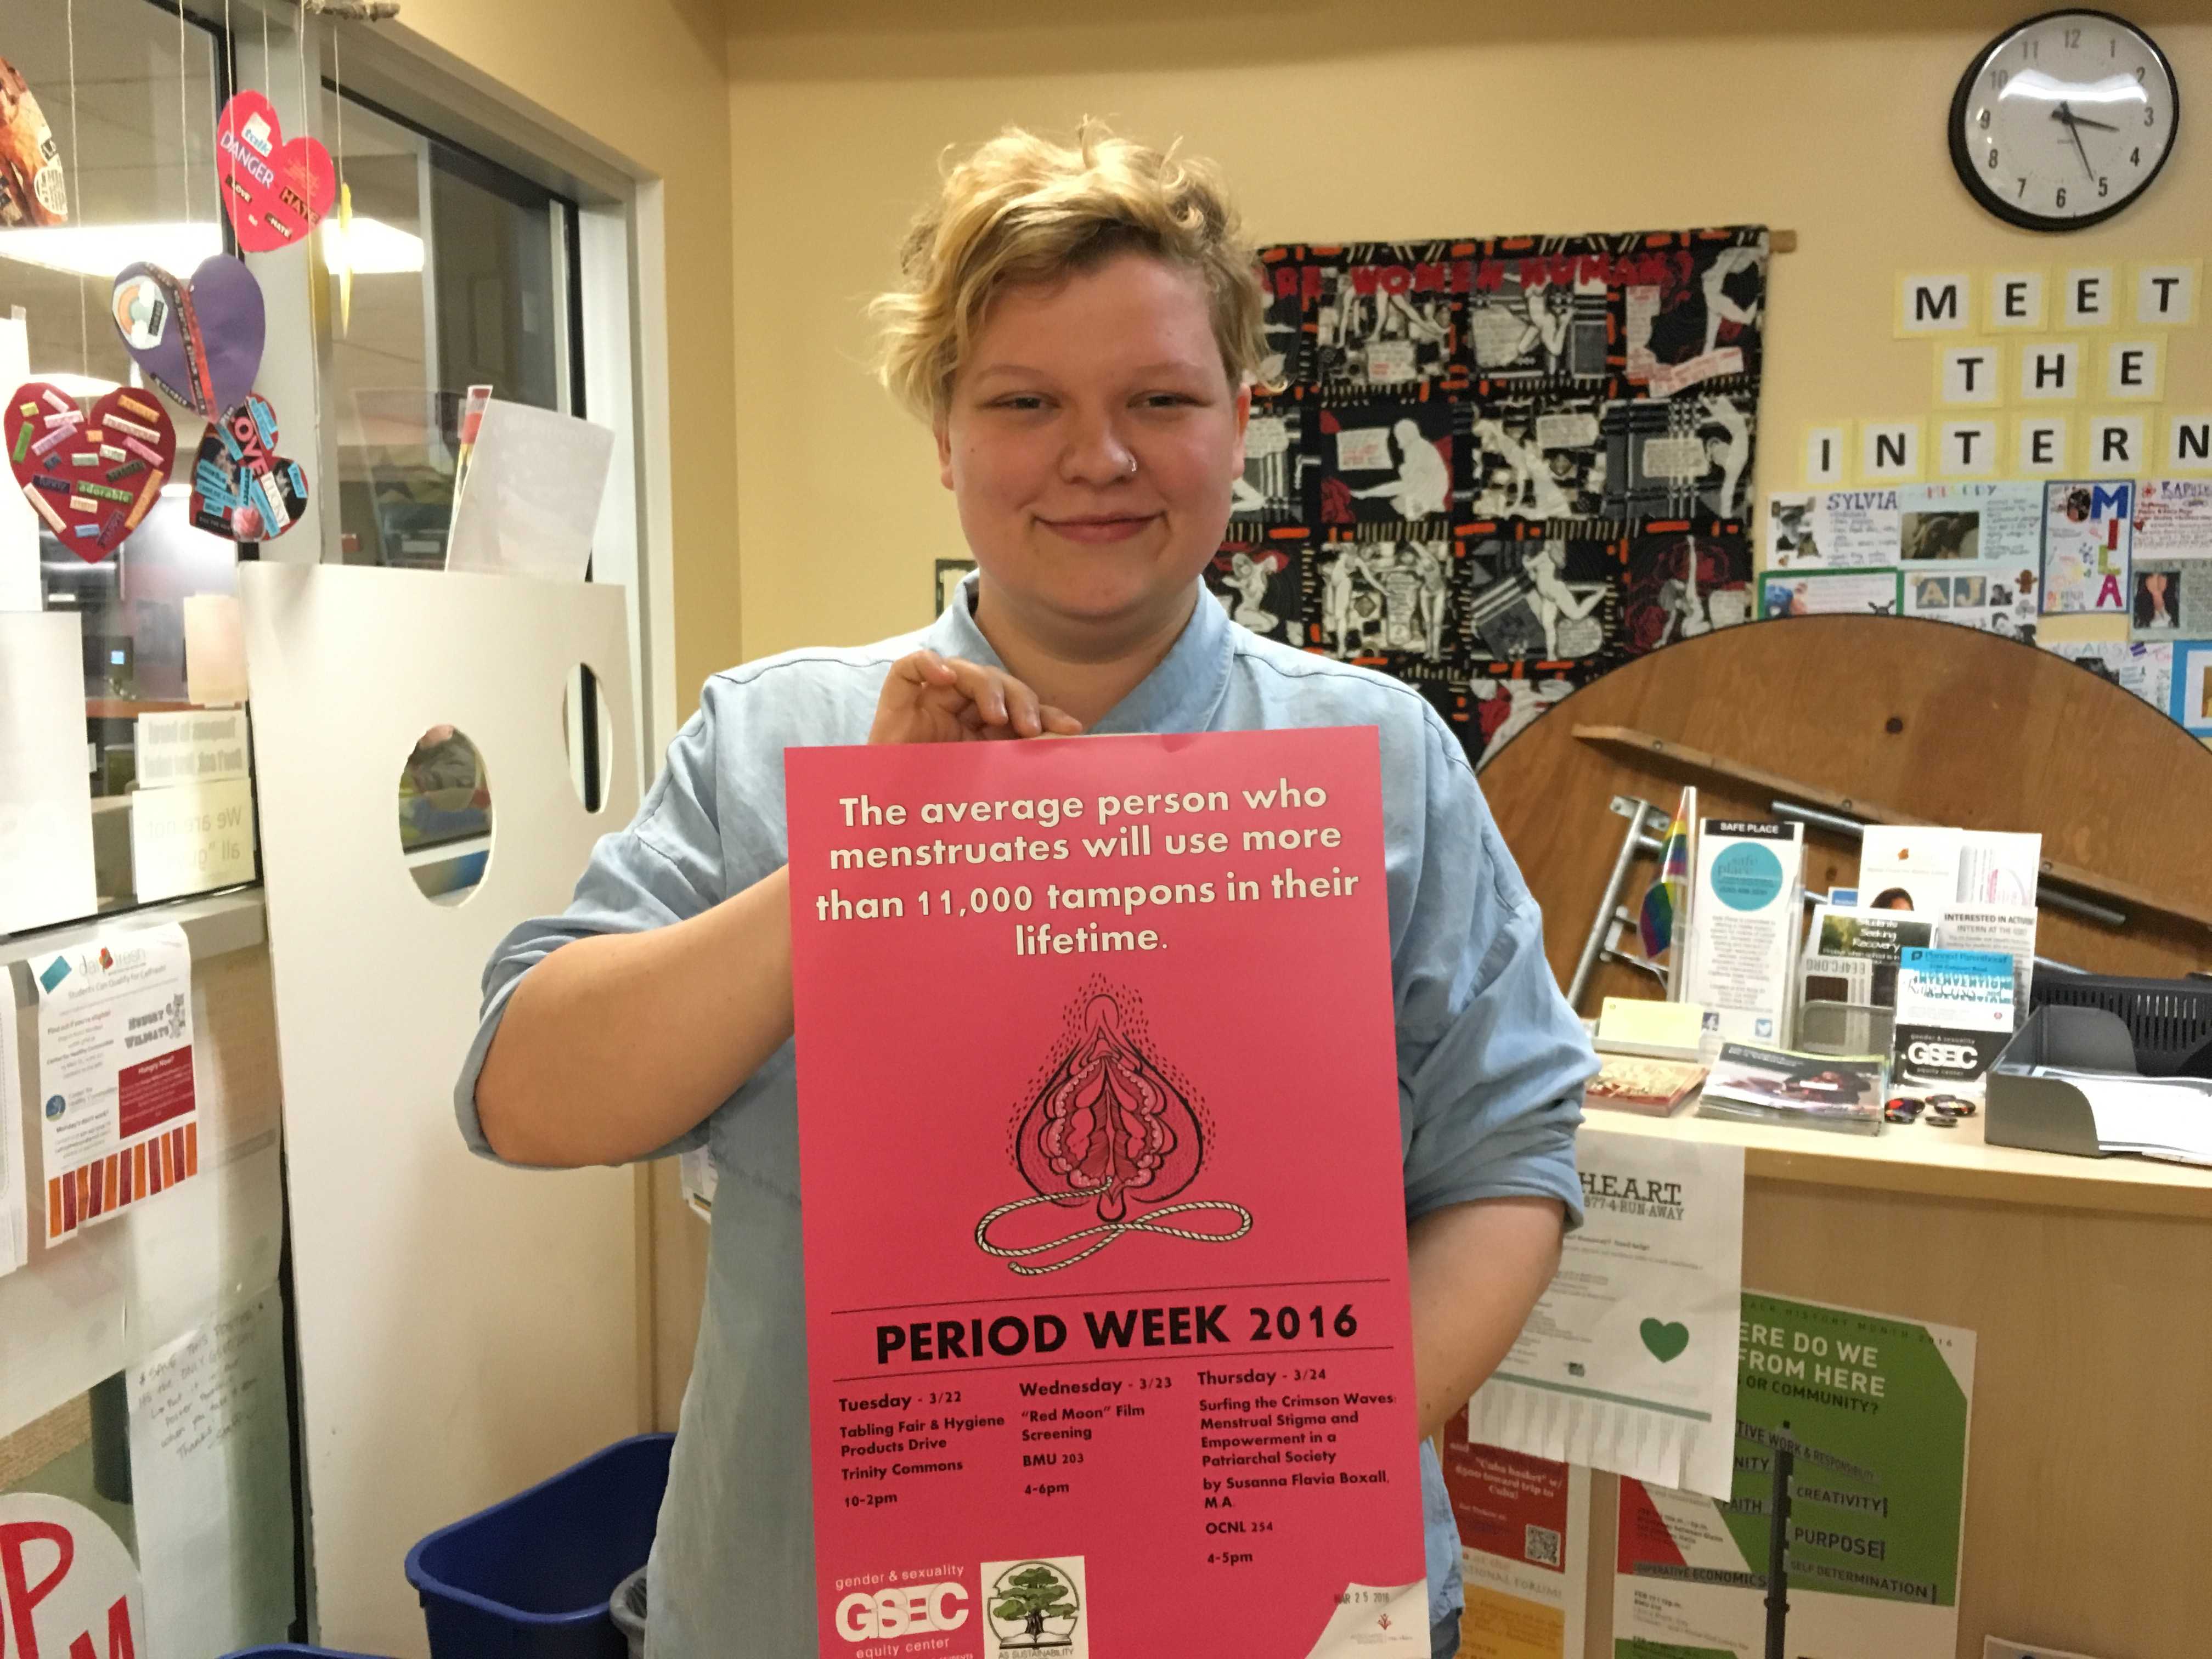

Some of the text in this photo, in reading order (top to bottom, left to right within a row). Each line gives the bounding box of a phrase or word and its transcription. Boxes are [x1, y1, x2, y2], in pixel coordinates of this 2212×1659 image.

[2064, 29, 2081, 49] 12
[2109, 39, 2115, 58] 1
[2022, 41, 2039, 59] 11
[1990, 70, 2008, 88] 10
[1980, 110, 1991, 129] 9
[2144, 107, 2154, 127] 3
[221, 131, 274, 189] DANGER
[1989, 149, 1999, 168] 8
[2130, 147, 2140, 166] 4
[2017, 178, 2027, 198] 7
[2098, 177, 2108, 197] 5
[2056, 188, 2066, 208] 6
[1351, 259, 1505, 295] WOMEN
[1916, 278, 2179, 321] MEET
[1957, 350, 2144, 392] THE
[232, 416, 269, 477] OVE
[78, 483, 133, 504] adorable
[1827, 491, 1898, 511] SYLVIA
[839, 777, 1327, 827] The average person who
[1720, 822, 1779, 834] SAFE PLACE
[830, 825, 1341, 870] menstruates will use more
[816, 867, 1359, 921] than 11,000 tampons in their
[1944, 913, 1996, 922] INTERESTED
[1015, 922, 1167, 956] lifetime.
[1853, 938, 1900, 953] Recovery
[1908, 1041, 1978, 1069] GSEC
[877, 1304, 1357, 1364] PERIOD WEEK 2016
[1740, 1321, 1878, 1369] ERE DO WE
[1198, 1369, 1276, 1386] Thursday
[1294, 1369, 1326, 1381] 3/24
[1738, 1348, 1886, 1398] FROM HERE
[1019, 1378, 1122, 1397] Wednesday
[1139, 1377, 1172, 1390] 3/23
[1746, 1375, 1879, 1415] OR COMMUNITY?
[839, 1393, 912, 1413] Tuesday
[929, 1391, 962, 1405] 3/22
[1116, 1404, 1145, 1417] Film
[1199, 1397, 1250, 1412] Surfing
[1255, 1396, 1277, 1409] the
[1282, 1393, 1339, 1407] Crimson
[840, 1416, 1005, 1438] Tabling Fair & Hygiene
[1200, 1411, 1358, 1430] Menstrual Stigma and
[1022, 1426, 1092, 1441] Screening
[1201, 1432, 1336, 1450] Empowerment in a
[840, 1437, 947, 1458] Products Drive
[1023, 1453, 1084, 1467] BMU 203
[1203, 1451, 1336, 1467] Patriarchal Society
[1734, 1456, 1770, 1471] NITY
[842, 1459, 963, 1481] Trinity Commons
[1025, 1483, 1069, 1497] 4-6pm
[1203, 1478, 1221, 1492] by
[1227, 1476, 1287, 1489] Susanna
[1292, 1472, 1335, 1486] Flavia
[845, 1493, 898, 1508] 10-2pm
[1797, 1486, 1882, 1512] CREATIVITY
[1205, 1521, 1273, 1534] OCNL 254
[1795, 1526, 1881, 1559] PURPOSE
[1207, 1551, 1253, 1566] 4-5pm
[836, 1564, 964, 1590] gender & sexuality
[1692, 1567, 1767, 1588] ECONOMICS
[1791, 1559, 1928, 1599] SELF DETERMINATION
[1374, 1592, 1390, 1603] 2016
[836, 1582, 969, 1643] GSEC
[856, 1638, 950, 1659] equity center
[1012, 1647, 1075, 1659] SUSTAINABILITY
